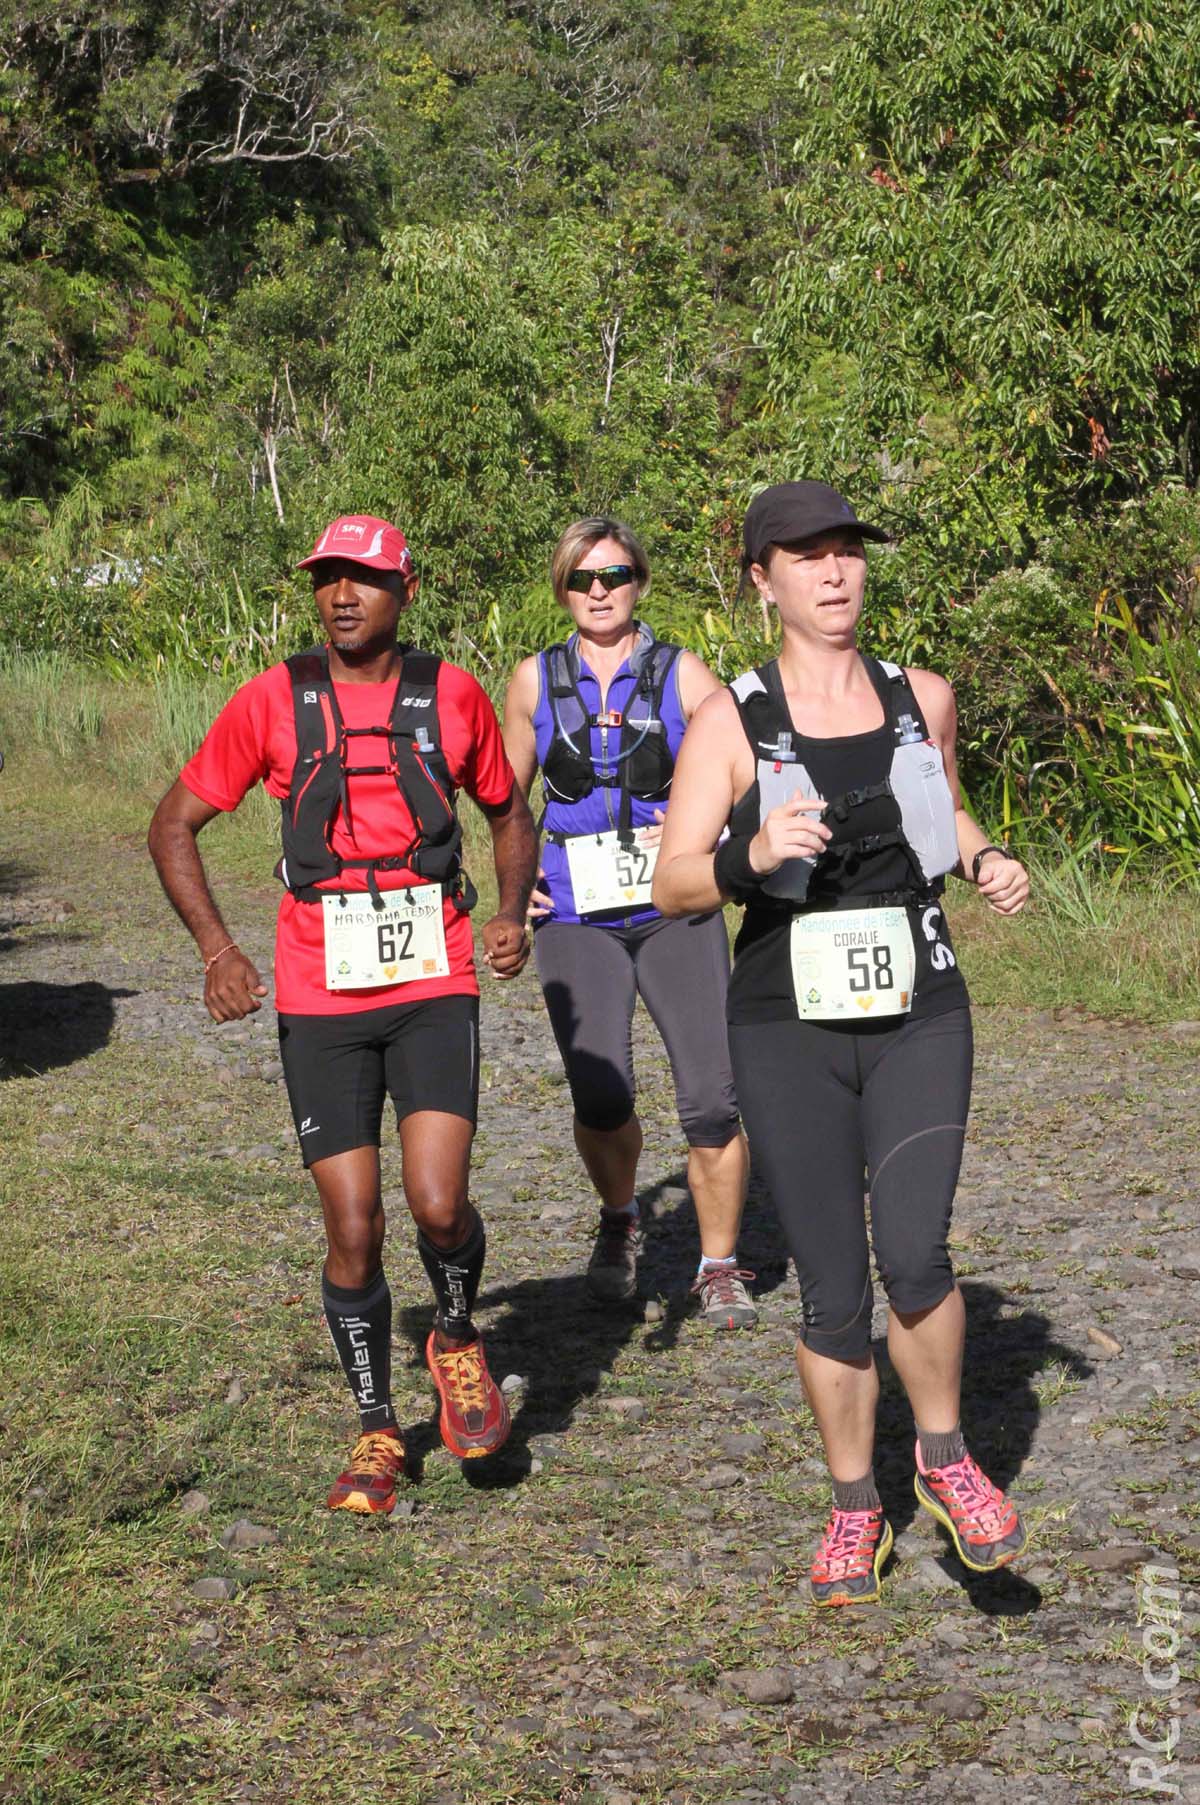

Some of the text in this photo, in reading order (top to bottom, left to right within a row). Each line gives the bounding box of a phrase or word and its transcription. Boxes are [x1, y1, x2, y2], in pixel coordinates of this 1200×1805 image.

[342, 525, 364, 535] SFR
[616, 853, 652, 888] 52
[401, 905, 439, 919] TEDDY
[377, 921, 415, 963] 62
[834, 930, 879, 948] CORALIE
[847, 945, 894, 992] 58
